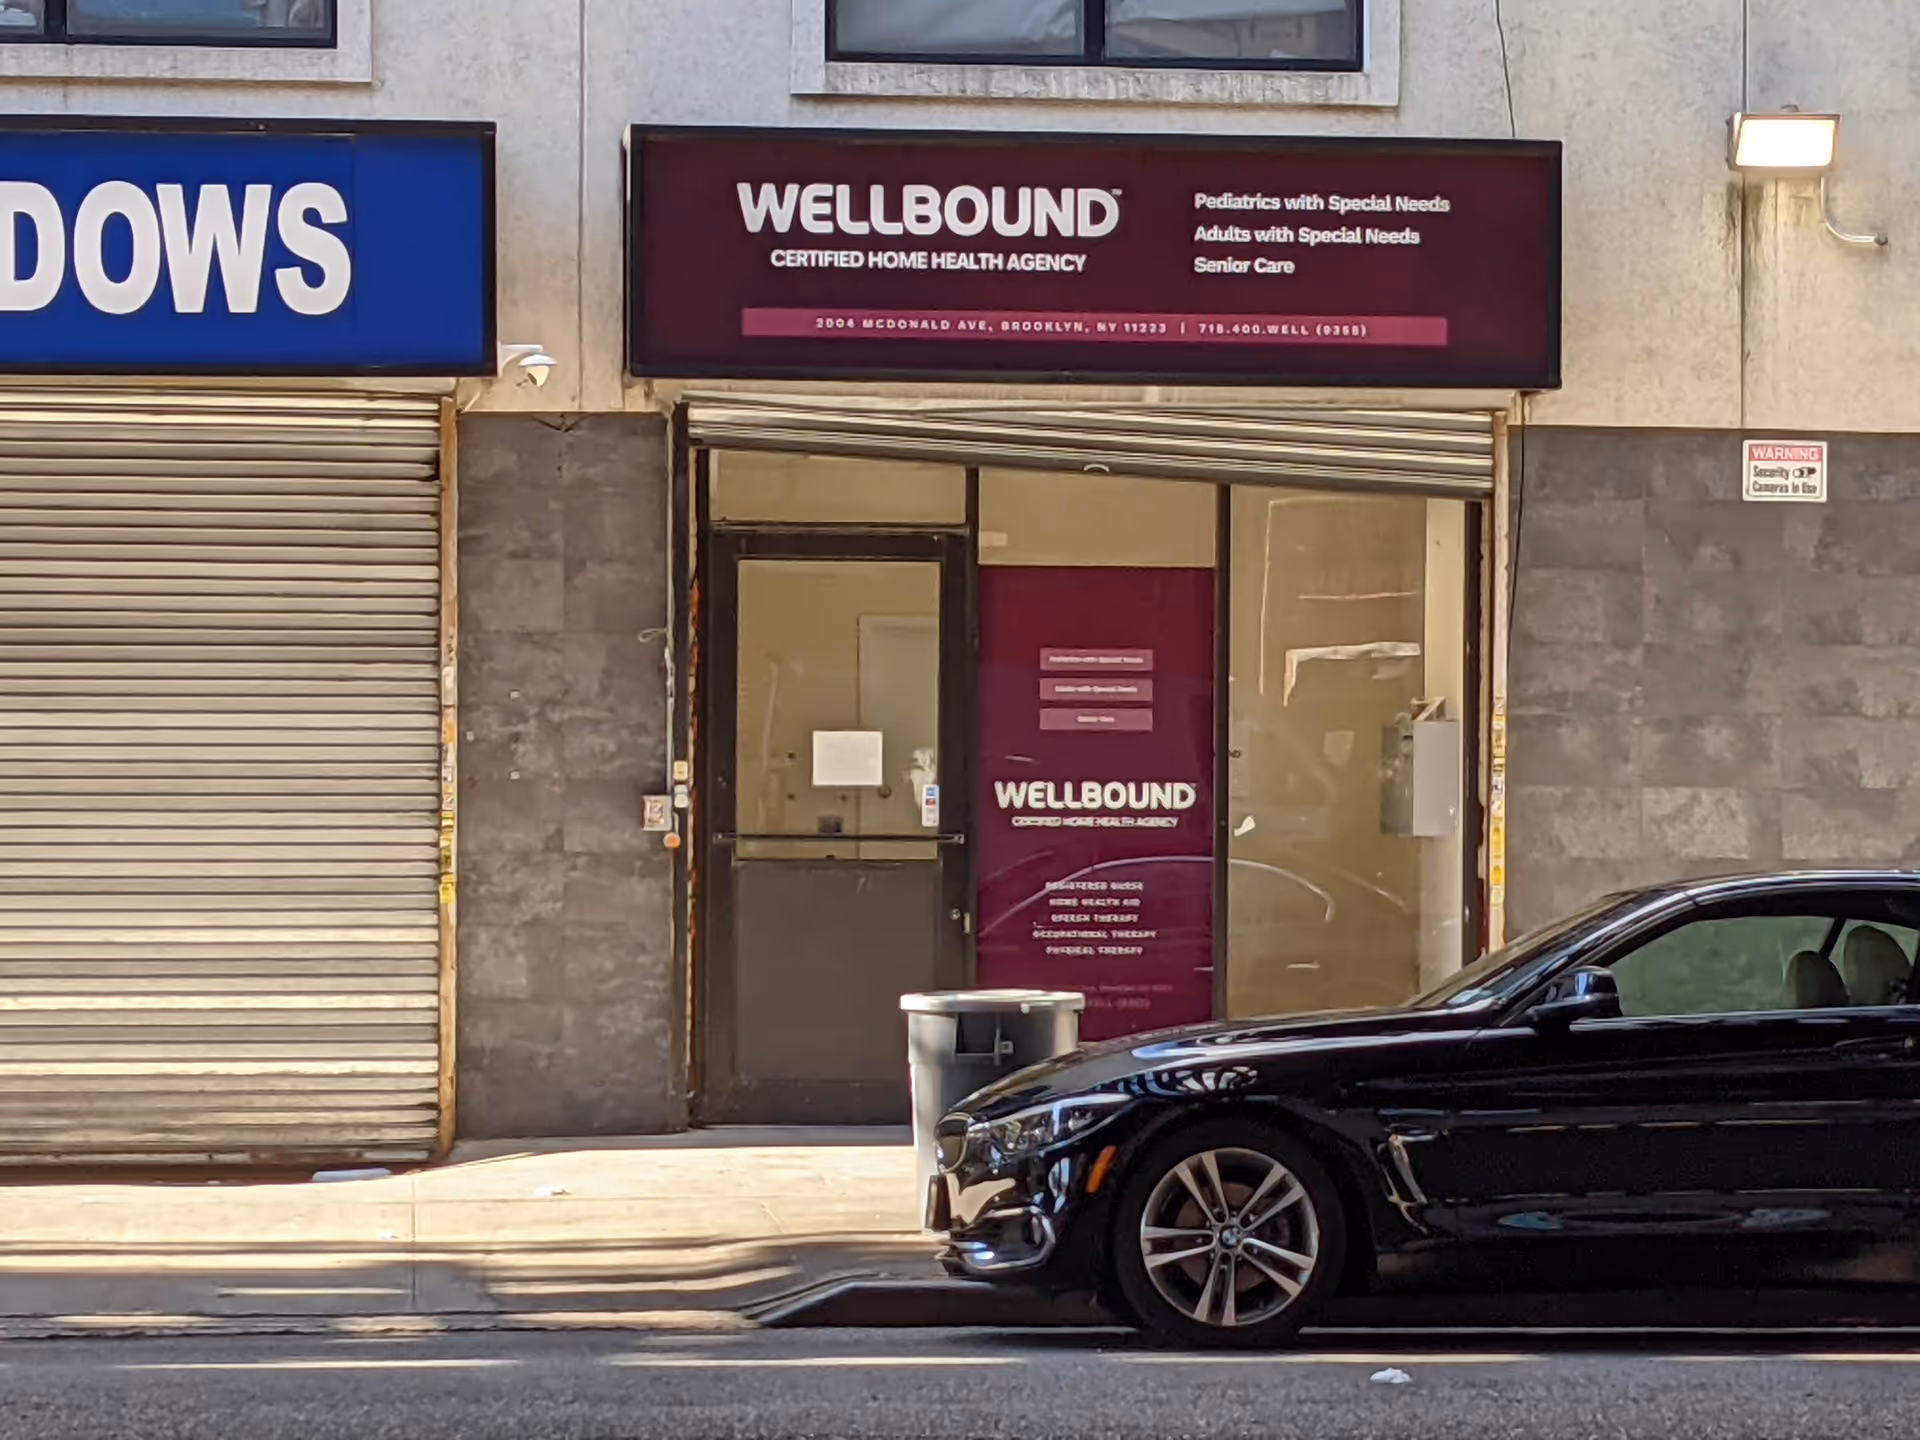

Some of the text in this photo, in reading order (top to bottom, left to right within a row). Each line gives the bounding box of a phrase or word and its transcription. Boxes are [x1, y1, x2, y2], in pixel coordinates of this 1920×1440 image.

[737, 183, 1119, 237] WELLBOUND
[1194, 192, 1451, 215] Pediatrics with Special Needs
[1194, 225, 1421, 247] Adults with Special Needs
[0, 180, 352, 316] DOWS
[771, 249, 1087, 273] CERTIFIED HOME HEALTH AGENCY
[1194, 256, 1296, 274] Senior Care
[862, 318, 951, 331] MCDONALD
[1096, 322, 1118, 333] NY
[1752, 446, 1819, 460] WARNNG
[994, 780, 1197, 811] WELLBOUND
